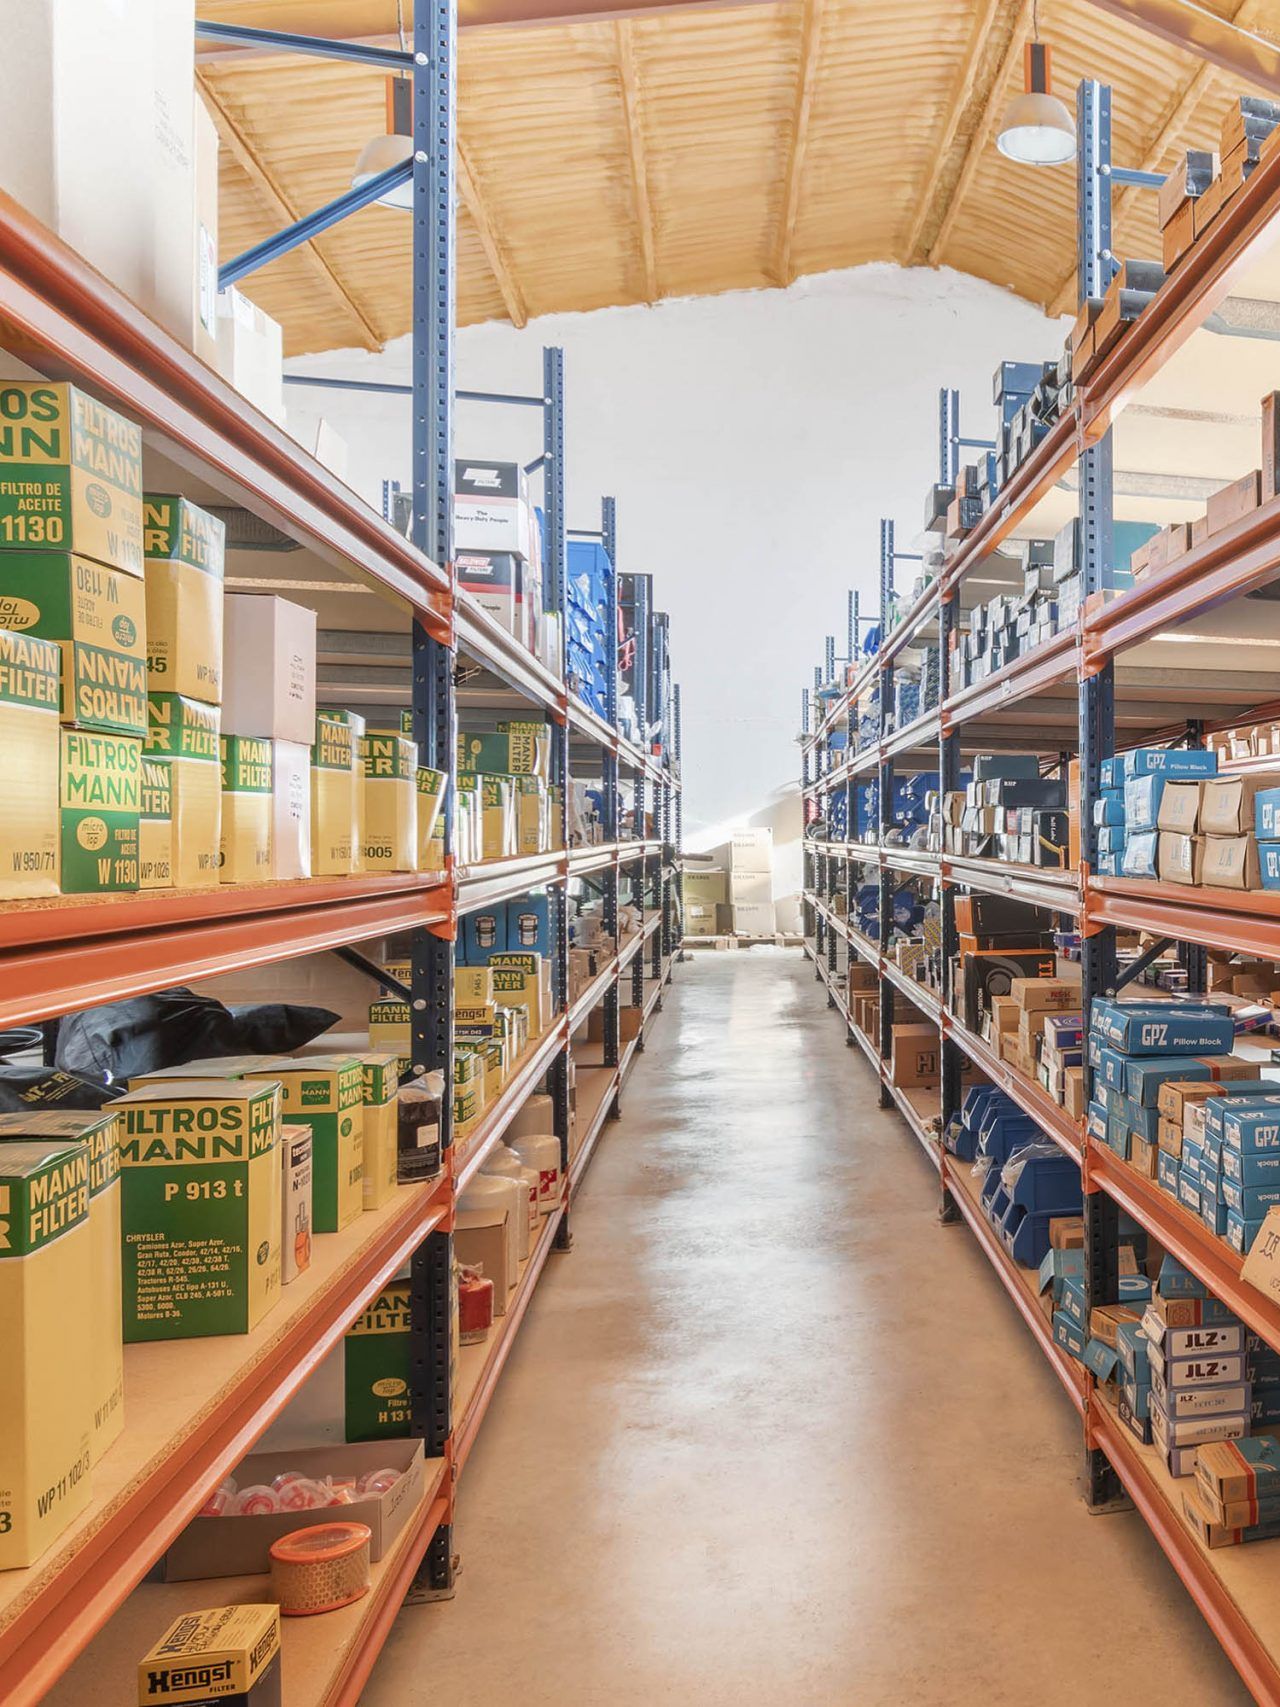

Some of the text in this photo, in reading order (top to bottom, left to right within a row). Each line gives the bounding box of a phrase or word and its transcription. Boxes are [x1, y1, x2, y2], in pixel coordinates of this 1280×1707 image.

[75, 395, 140, 459] FILTROS
[75, 437, 142, 488] MANN
[17, 497, 62, 512] ACEITE
[1, 637, 58, 673] MANN
[1, 668, 58, 704] FILTER
[80, 649, 145, 694] MANN
[67, 735, 138, 773] FILTROS
[67, 772, 138, 804] MANN
[489, 955, 533, 967] MANN
[371, 1005, 411, 1014] MANN
[456, 1007, 487, 1021] engst
[119, 1105, 243, 1136] FILTROS
[119, 1134, 244, 1162] MANN
[29, 1153, 89, 1210] MANN
[165, 1178, 244, 1201] P 913 t
[29, 1190, 89, 1245] FILTER
[126, 1232, 165, 1243] CHRYSLER
[1185, 1332, 1219, 1349] JLZ
[1185, 1362, 1219, 1379] JLZ
[37, 1490, 55, 1519] WP
[147, 1659, 235, 1694] Hengst
